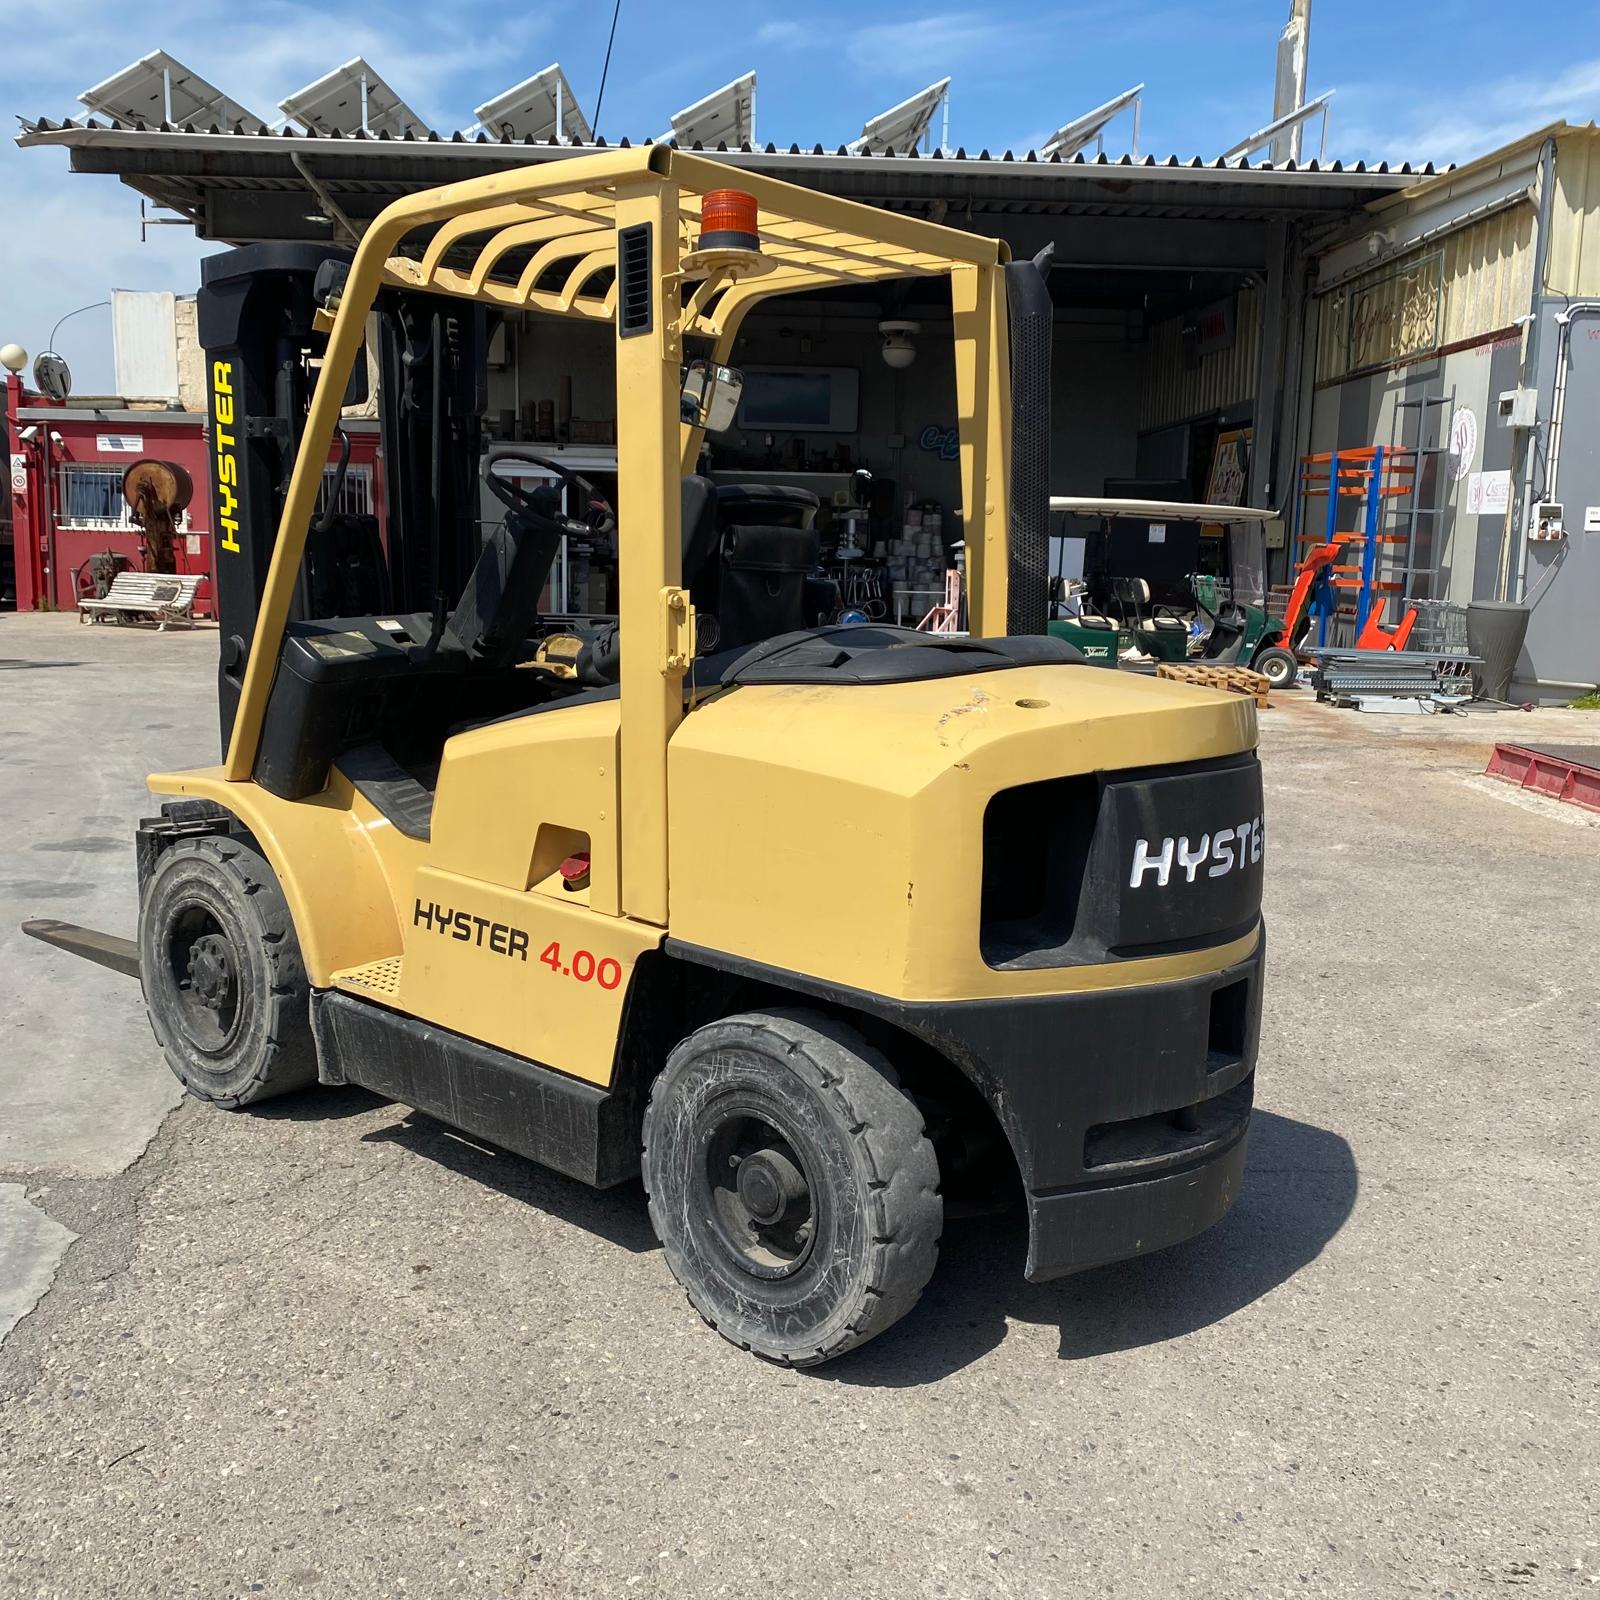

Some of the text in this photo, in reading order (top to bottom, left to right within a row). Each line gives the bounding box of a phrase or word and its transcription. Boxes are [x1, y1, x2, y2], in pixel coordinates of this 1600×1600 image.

[214, 361, 240, 553] HYSTER
[1129, 813, 1264, 888] HYSTE
[414, 898, 622, 990] HYSTER 4.00
